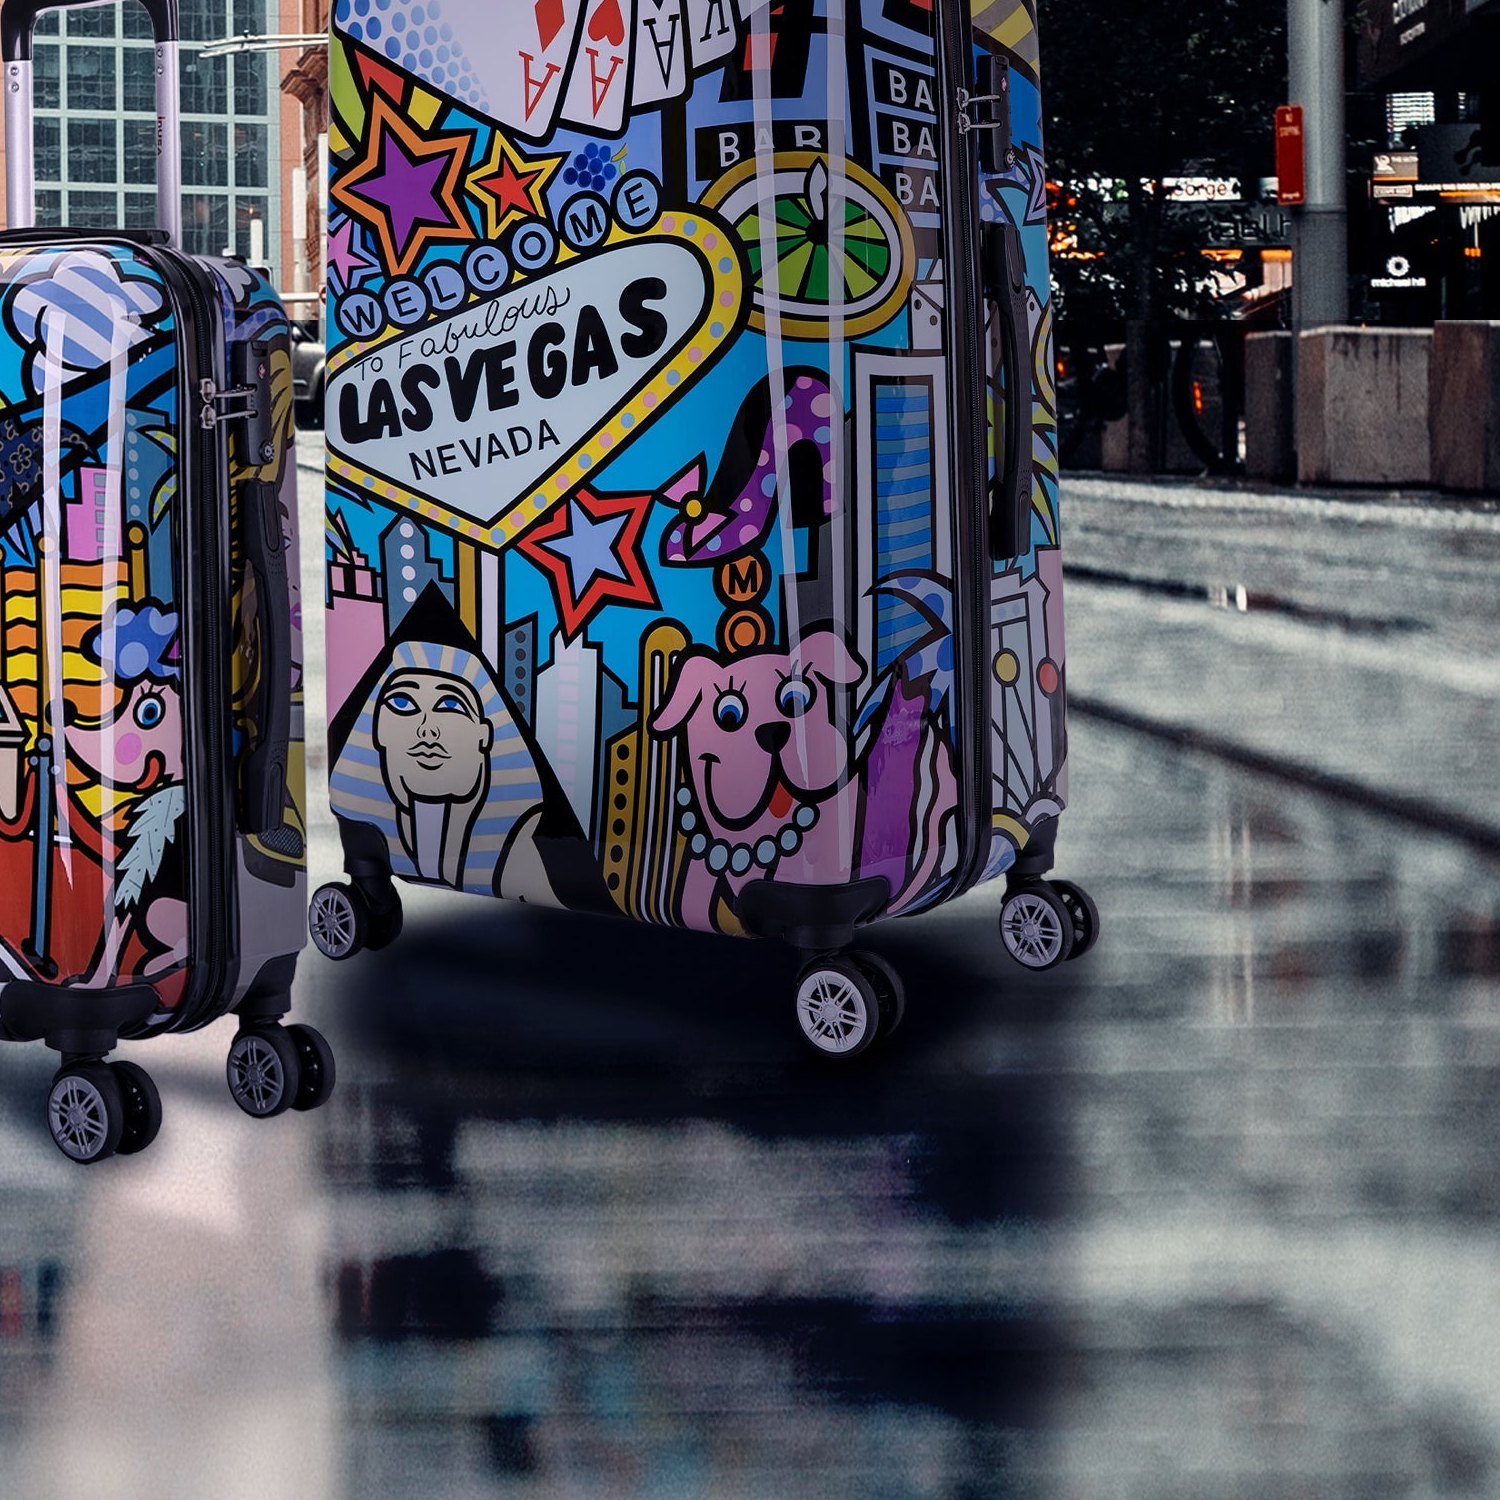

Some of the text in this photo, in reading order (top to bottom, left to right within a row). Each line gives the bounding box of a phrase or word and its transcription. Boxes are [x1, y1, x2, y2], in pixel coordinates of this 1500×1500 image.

[718, 125, 822, 167] BAR
[342, 183, 650, 334] WELCOME
[338, 277, 668, 444] LAS VEGAS
[398, 285, 570, 370] Fabulous
[408, 418, 561, 481] NEVADA
